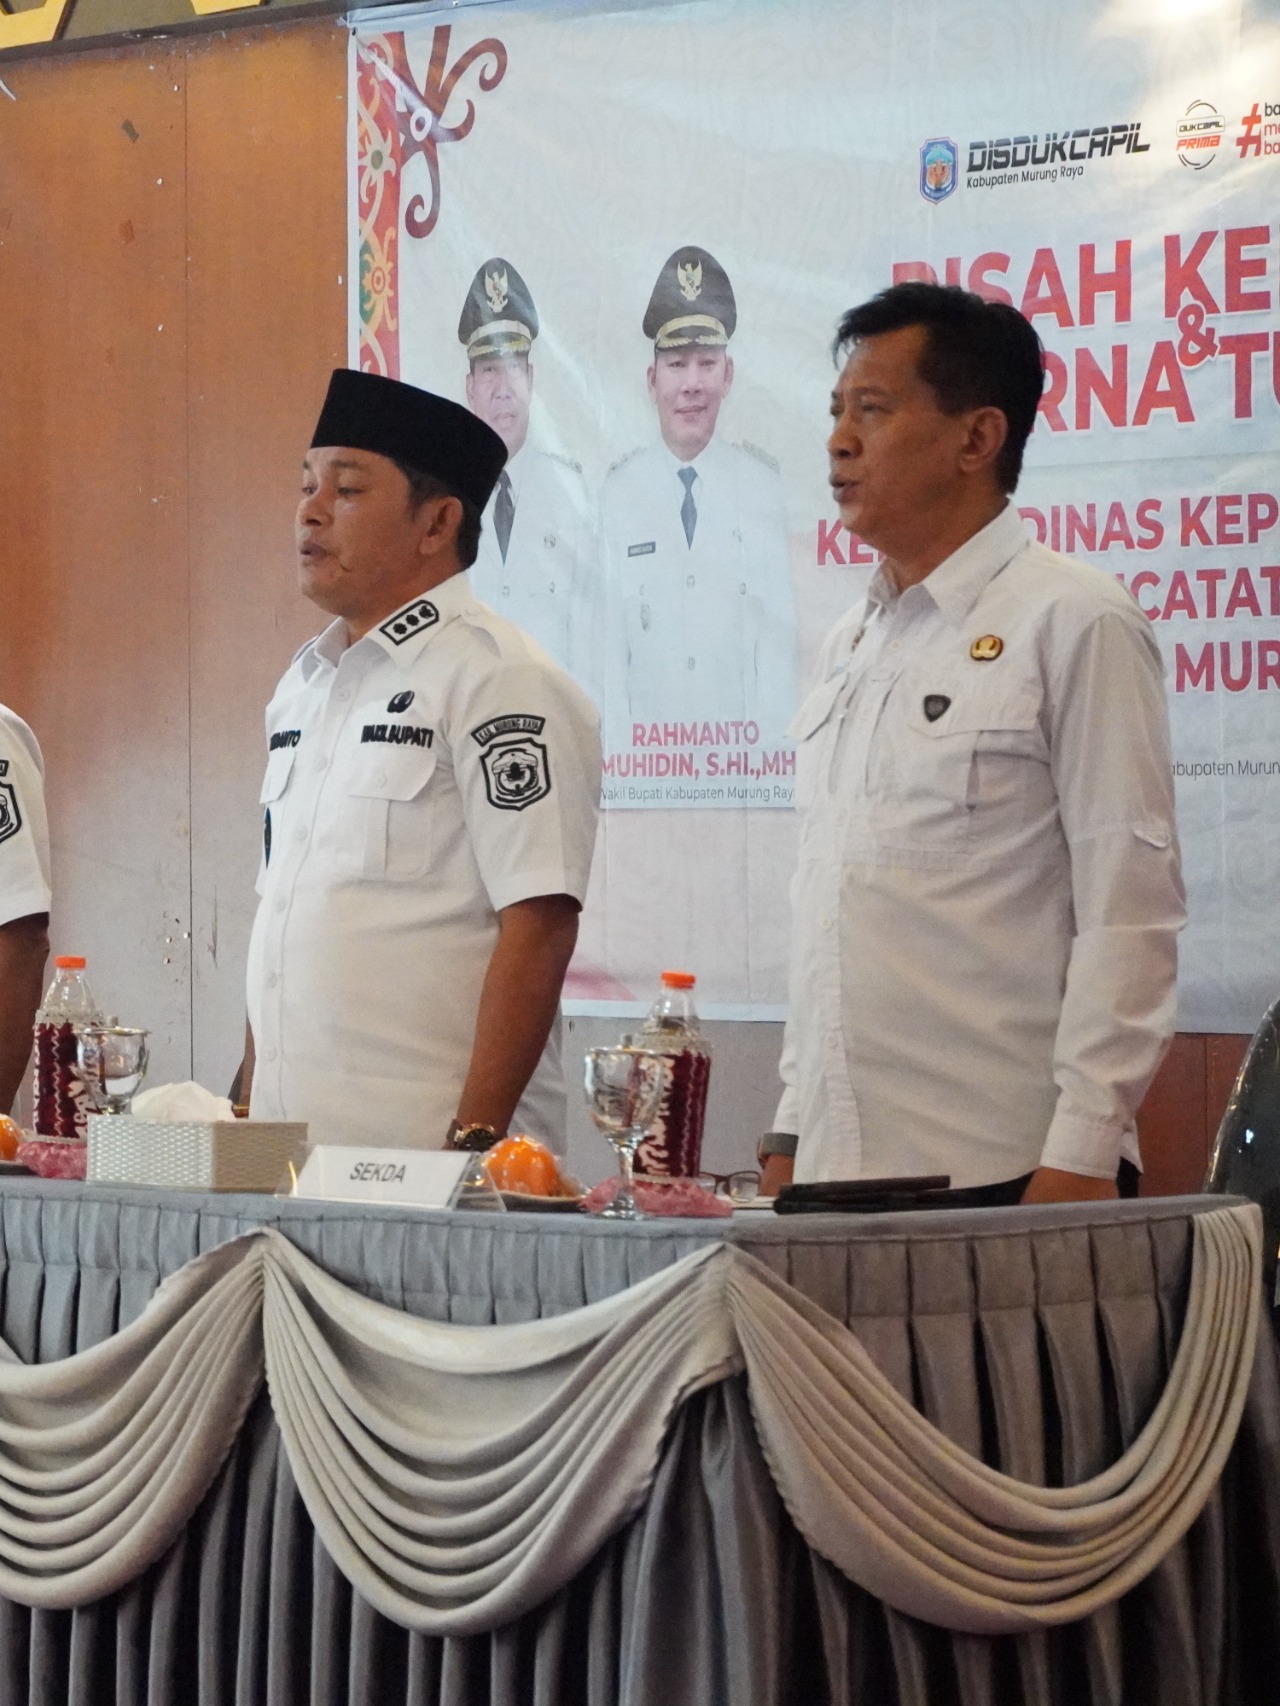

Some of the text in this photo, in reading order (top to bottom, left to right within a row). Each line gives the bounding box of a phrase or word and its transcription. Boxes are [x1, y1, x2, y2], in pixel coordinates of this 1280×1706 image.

[966, 122, 1151, 173] DISDUKCAPIL
[1264, 122, 1280, 136] m
[966, 165, 1084, 190] Kabupaten Murung Raya
[1164, 225, 1280, 318] KE
[1177, 303, 1219, 367] &
[1219, 331, 1280, 418] T
[817, 519, 887, 566] KE
[1115, 565, 1280, 622] CATAT
[632, 720, 760, 747] RAHMANTO
[628, 786, 663, 803] Bupati
[666, 786, 724, 801] Kabupaten
[727, 786, 770, 801] Murung
[773, 786, 795, 801] Ray
[350, 1162, 407, 1183] SEKDA
